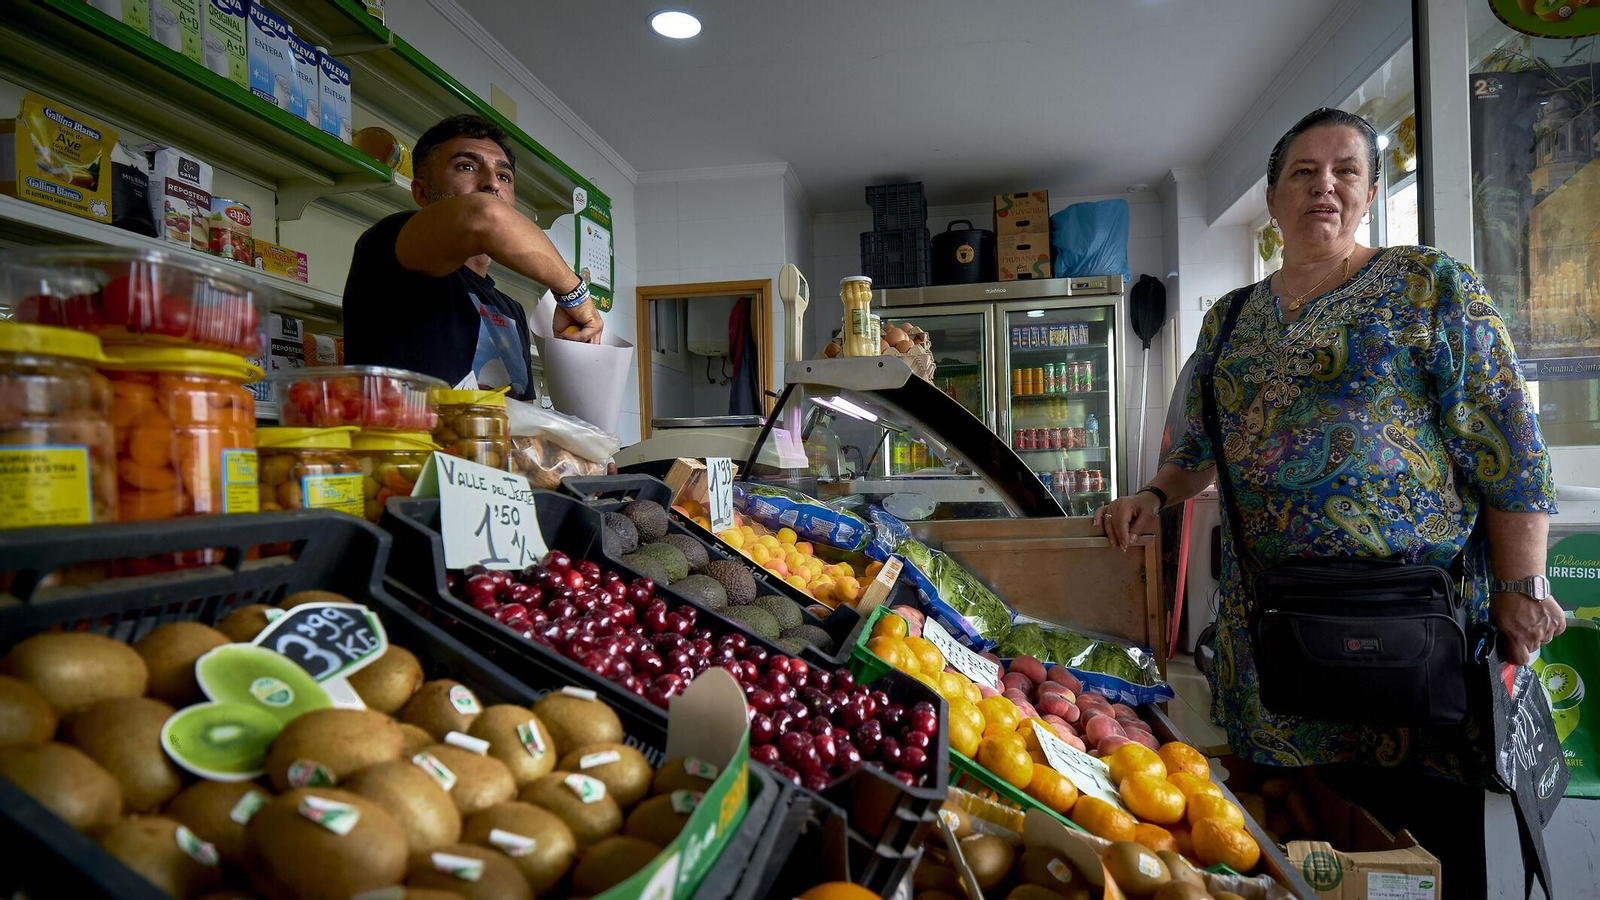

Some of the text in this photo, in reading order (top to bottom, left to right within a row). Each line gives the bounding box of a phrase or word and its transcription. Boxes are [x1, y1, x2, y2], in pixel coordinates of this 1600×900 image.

[208, 4, 241, 33] ORIGINAL
[250, 6, 287, 35] PULEVA
[254, 38, 284, 60] ENTERA
[287, 35, 316, 61] PULEVA
[320, 56, 349, 80] PULEVA
[324, 85, 347, 104] ENTERA
[45, 108, 100, 141] Gallina Blanca
[55, 133, 82, 152] Ave
[28, 178, 81, 200] Gallina Blanca
[121, 173, 148, 188] MILENIA
[167, 183, 210, 205] REPOSTERÍA
[230, 208, 251, 224] apis
[1541, 361, 1574, 375] Semana
[438, 455, 488, 491] VALLE
[491, 484, 507, 496] DEL
